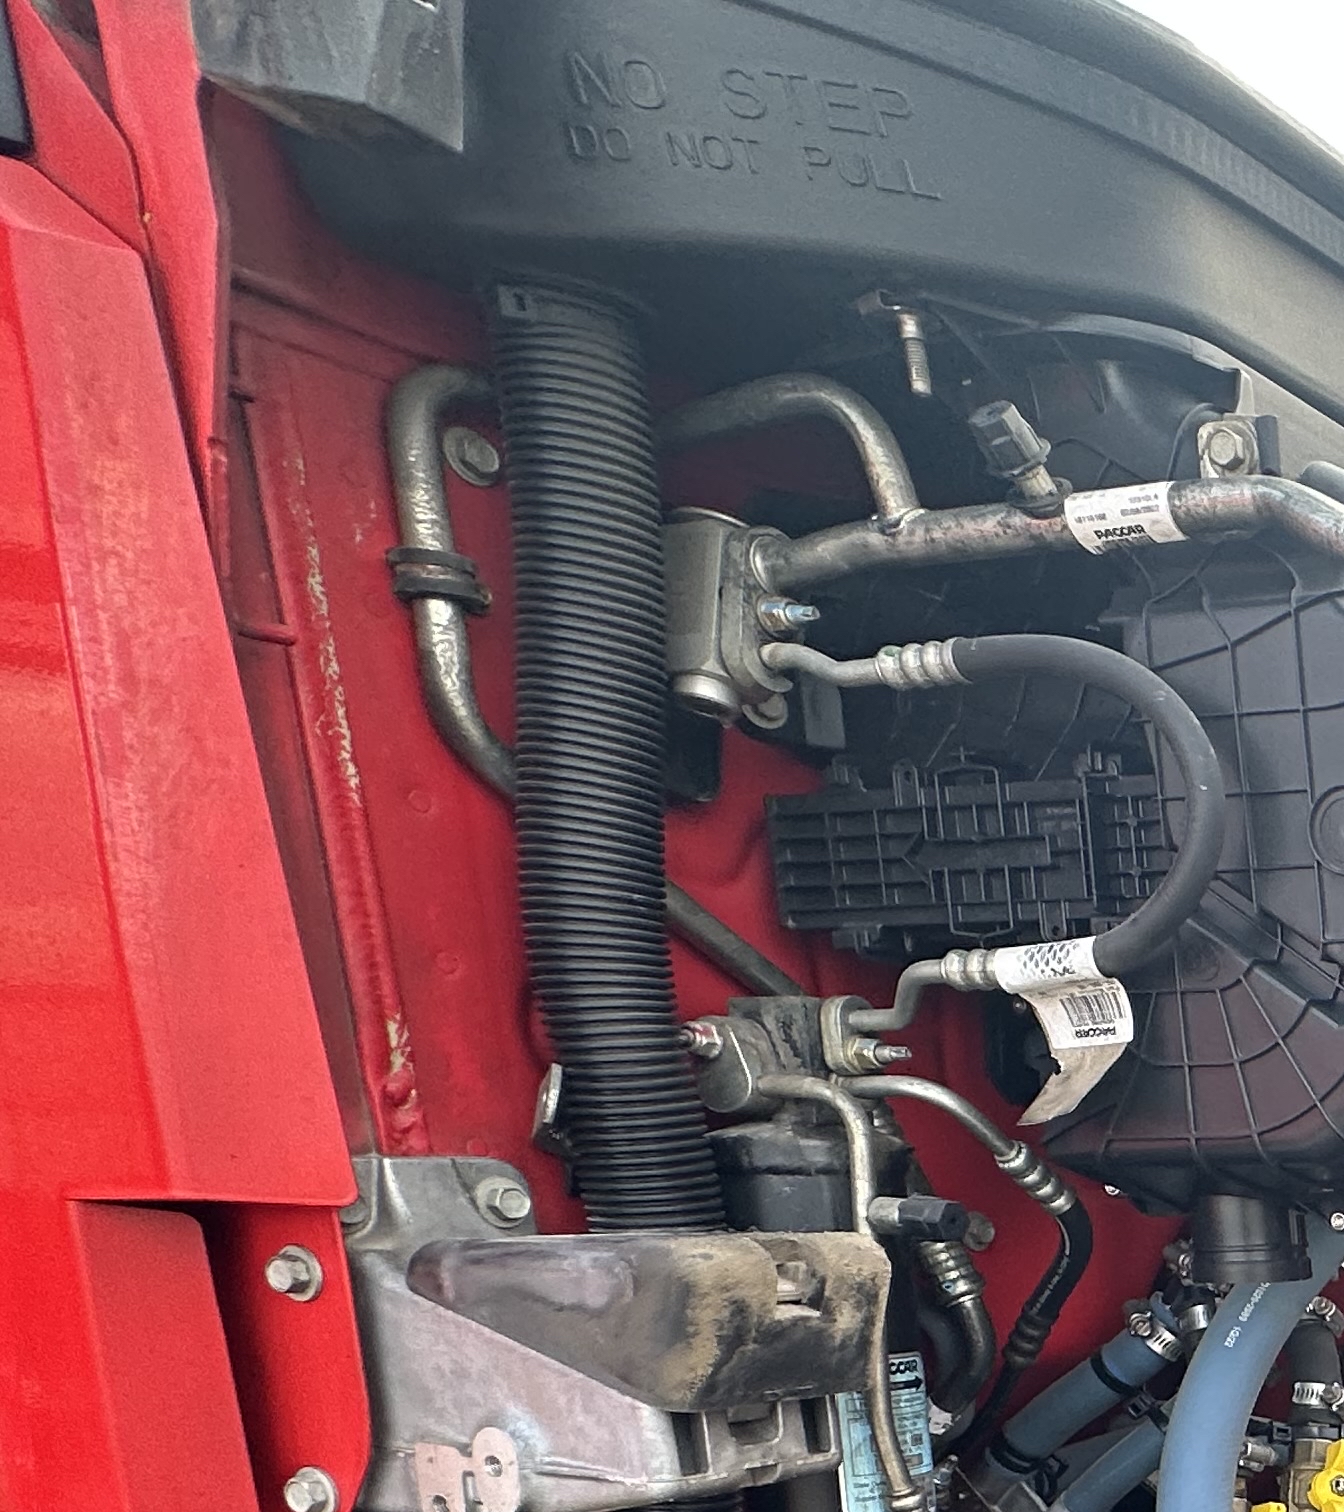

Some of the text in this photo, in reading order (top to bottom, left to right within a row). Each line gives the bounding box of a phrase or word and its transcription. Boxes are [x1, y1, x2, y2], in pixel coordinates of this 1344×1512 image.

[565, 49, 913, 139] NO STEP
[567, 121, 941, 200] DO NOT PULL
[1093, 524, 1146, 540] PACCAR
[1075, 1027, 1117, 1039] PACCAR
